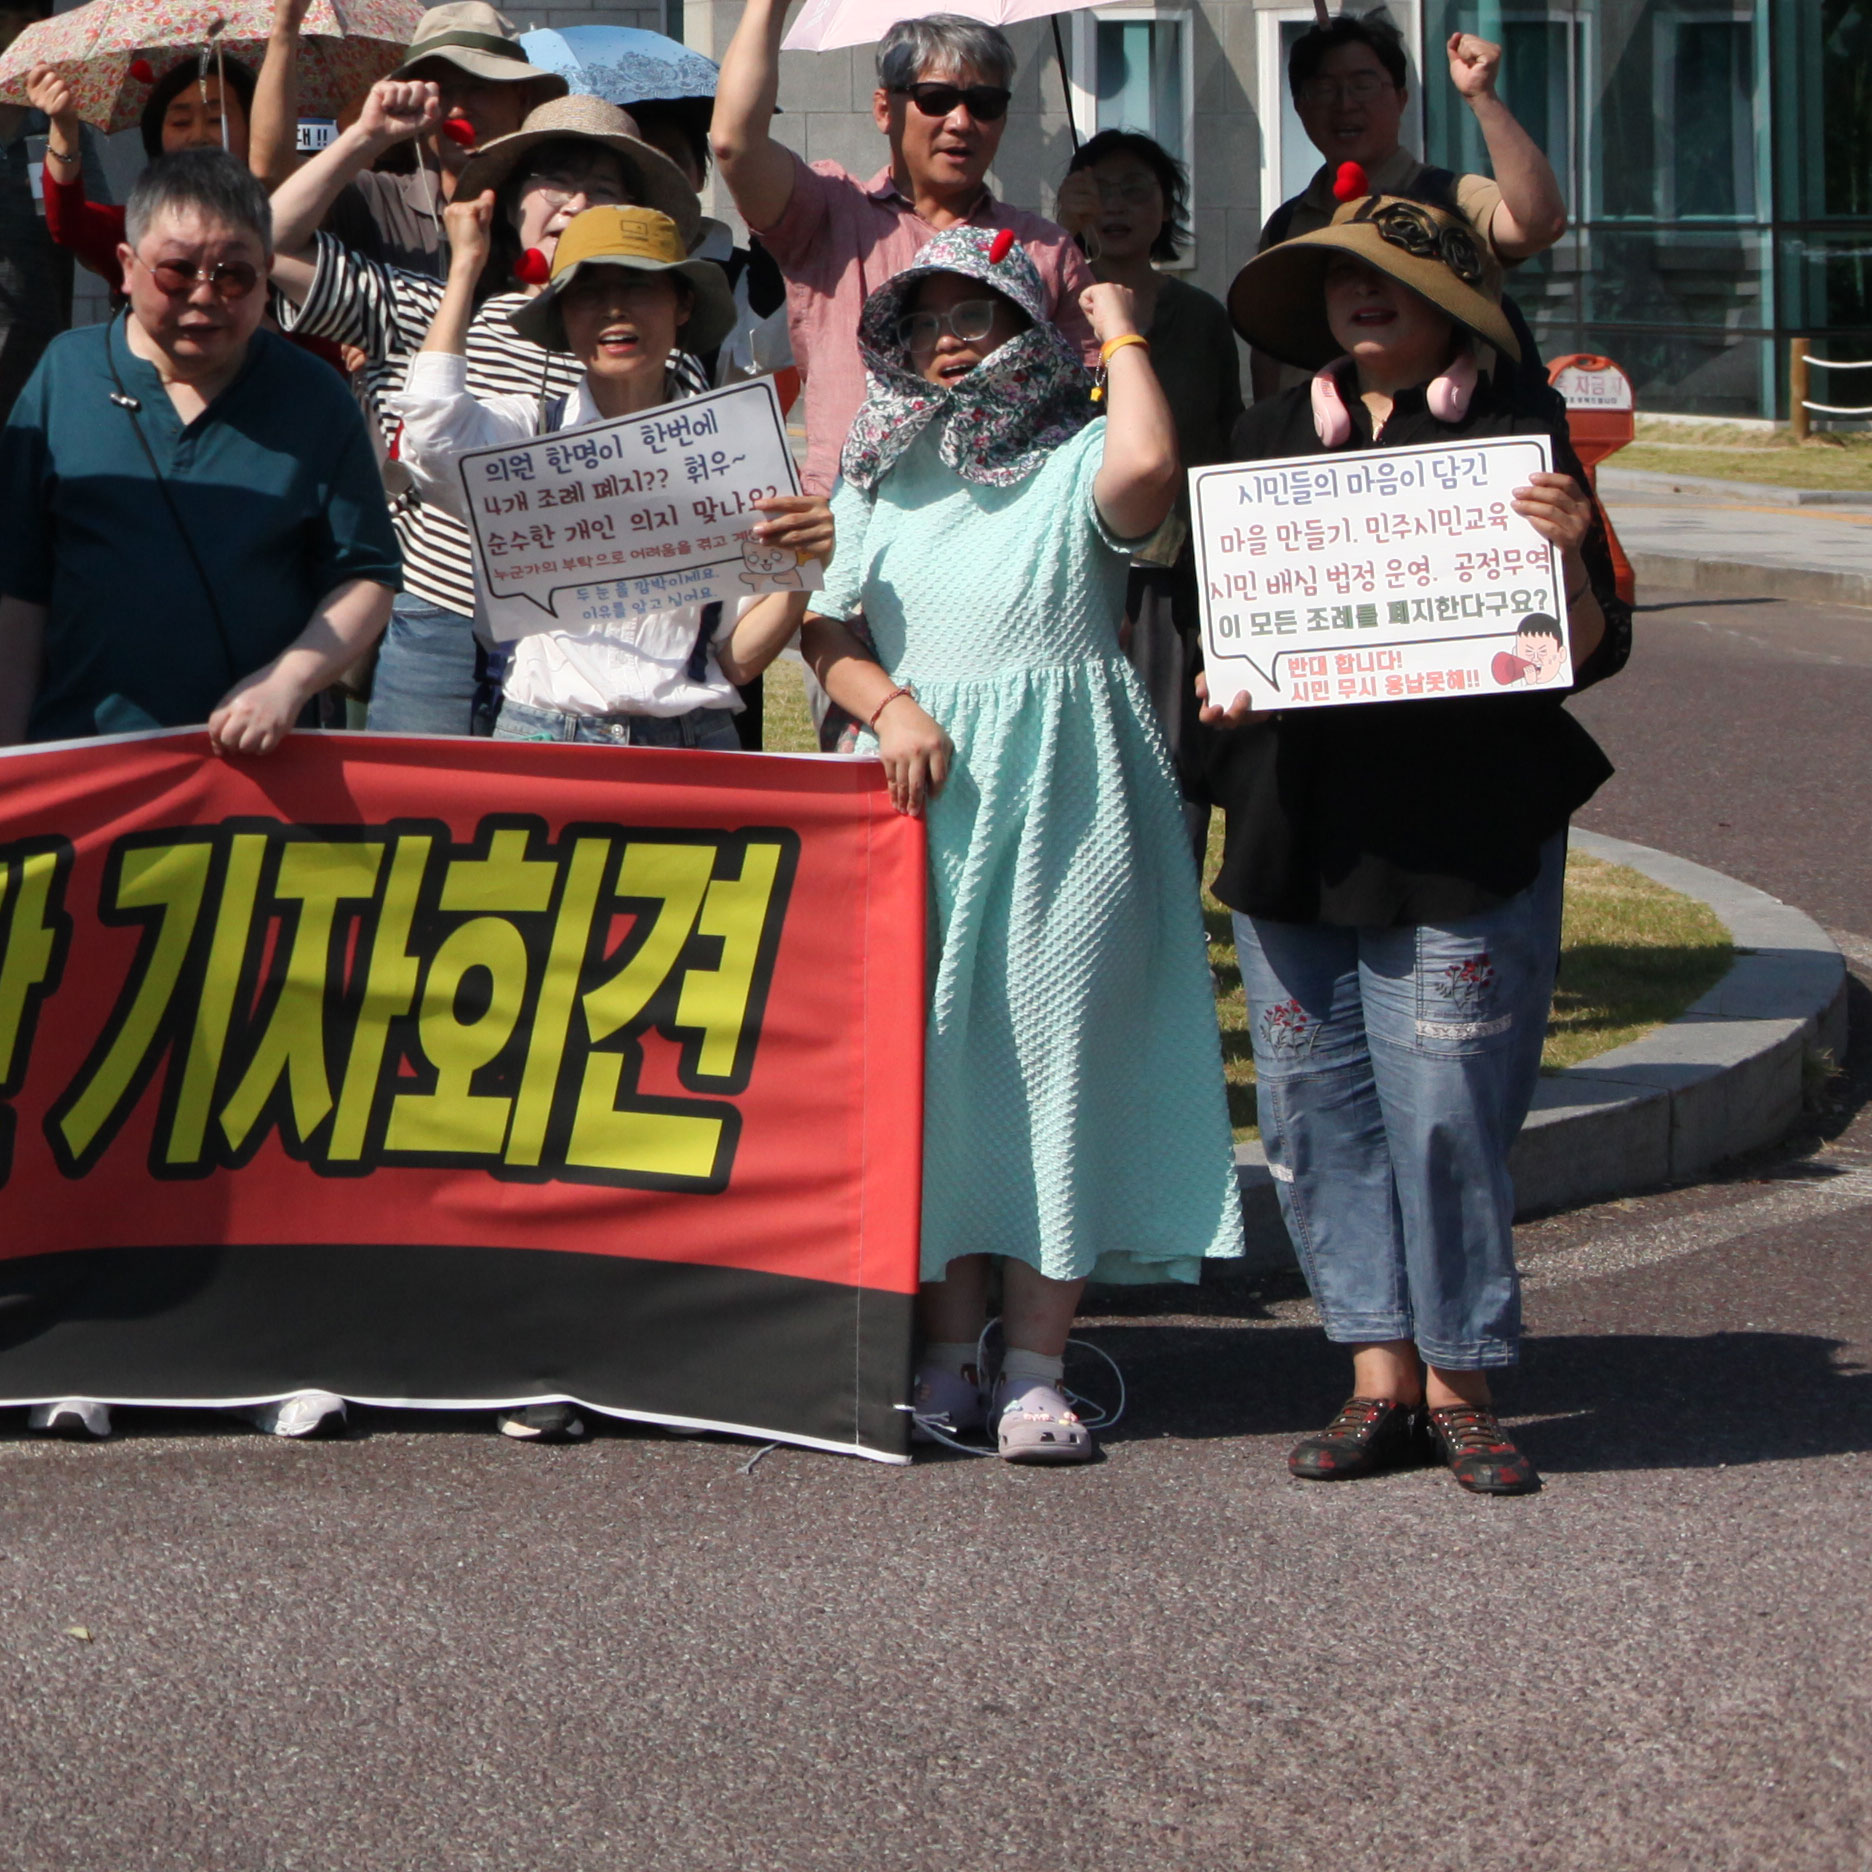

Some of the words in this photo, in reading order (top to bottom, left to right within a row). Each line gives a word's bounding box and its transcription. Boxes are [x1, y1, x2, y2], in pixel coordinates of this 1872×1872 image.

[486, 454, 536, 483] 의원
[547, 436, 623, 473] 한명이
[641, 410, 719, 454] 한번에
[483, 490, 528, 516] 4개
[537, 482, 585, 508] 조례
[594, 469, 668, 499] 폐지??
[1238, 469, 1339, 505] 시민들의
[1347, 462, 1425, 496] 마음이
[1433, 453, 1488, 488] 담긴
[487, 524, 554, 556] 순수한
[565, 515, 615, 542] 개인
[630, 506, 678, 531] 의지
[1220, 525, 1268, 555] 마을
[1366, 502, 1509, 544] 민주시민교육
[1210, 570, 1257, 601] 시민
[1266, 565, 1317, 596] 배심
[1327, 560, 1375, 593] 법정
[1454, 545, 1550, 583] 공정무역
[1219, 614, 1241, 638] 이
[1251, 609, 1297, 636] 모든
[1307, 602, 1378, 633] 조례를
[1387, 588, 1548, 625] 폐지한다구요?
[1287, 658, 1328, 678] 반대
[1335, 651, 1402, 673] 합니다!
[1291, 681, 1330, 702] 시민
[1338, 677, 1377, 698] 무시
[59, 827, 781, 1177] 기자회견
